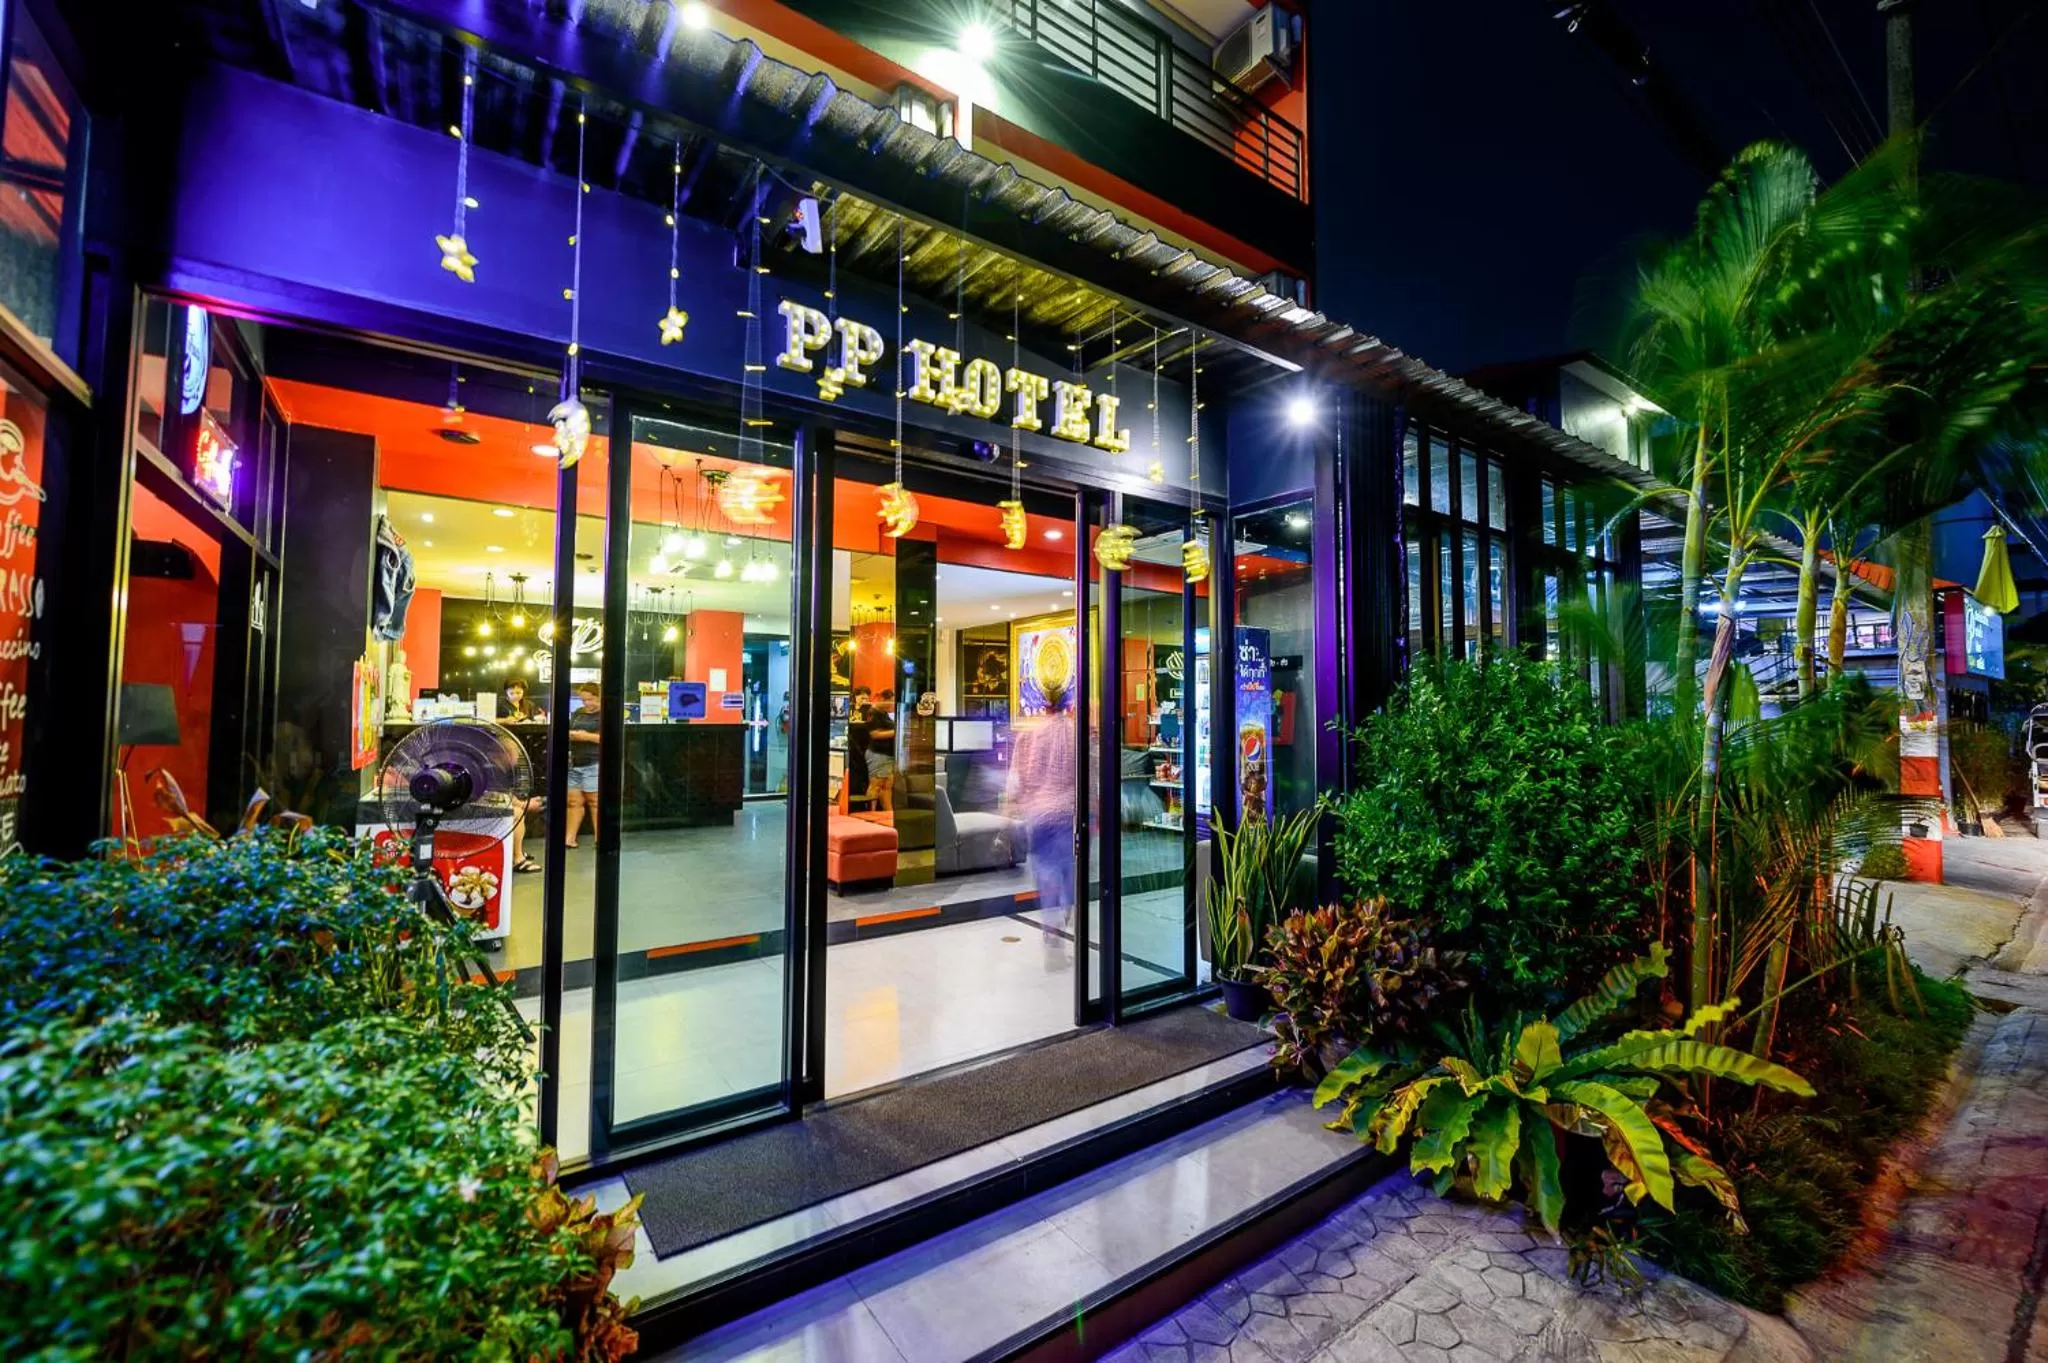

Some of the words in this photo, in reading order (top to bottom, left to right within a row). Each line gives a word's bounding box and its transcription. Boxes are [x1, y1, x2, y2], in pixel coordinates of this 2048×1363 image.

[776, 300, 885, 388] PP
[907, 337, 1131, 455] HOTEL
[0, 508, 35, 560] ffee
[0, 627, 41, 661] ccino
